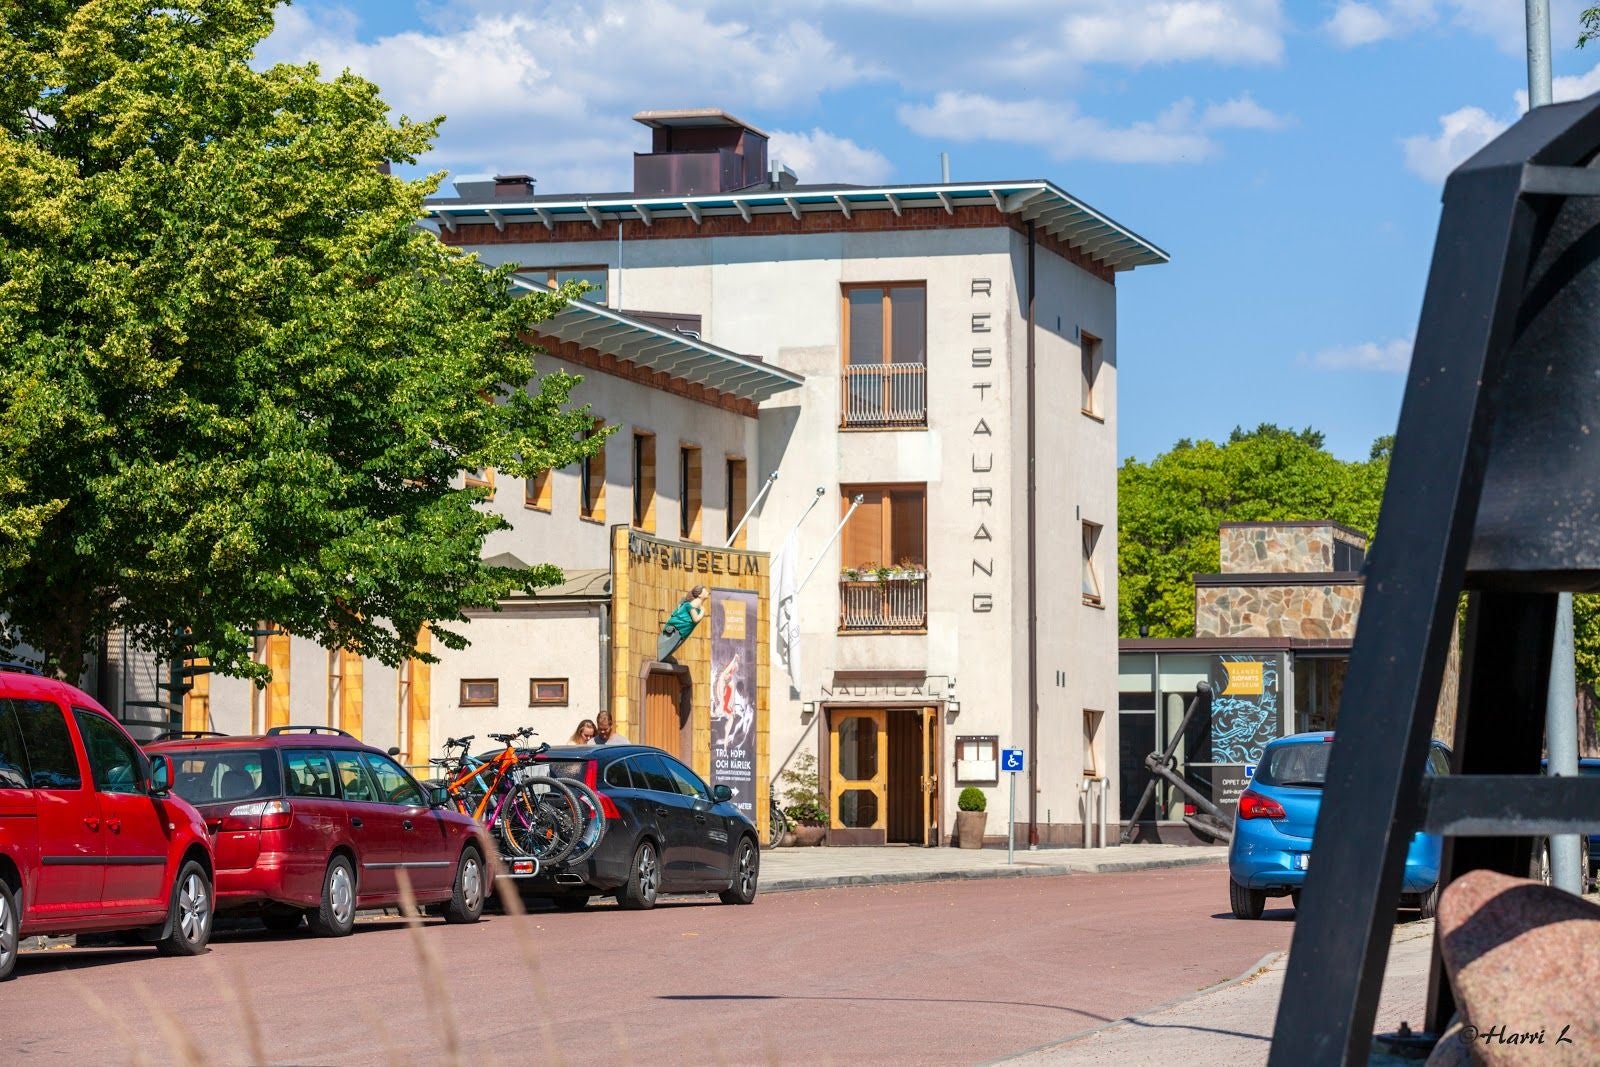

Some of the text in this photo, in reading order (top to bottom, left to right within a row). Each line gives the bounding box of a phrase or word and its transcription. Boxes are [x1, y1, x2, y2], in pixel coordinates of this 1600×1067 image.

[971, 277, 993, 613] RESTAURANG
[821, 684, 940, 696] NAUTICAL
[716, 760, 728, 768] OCH
